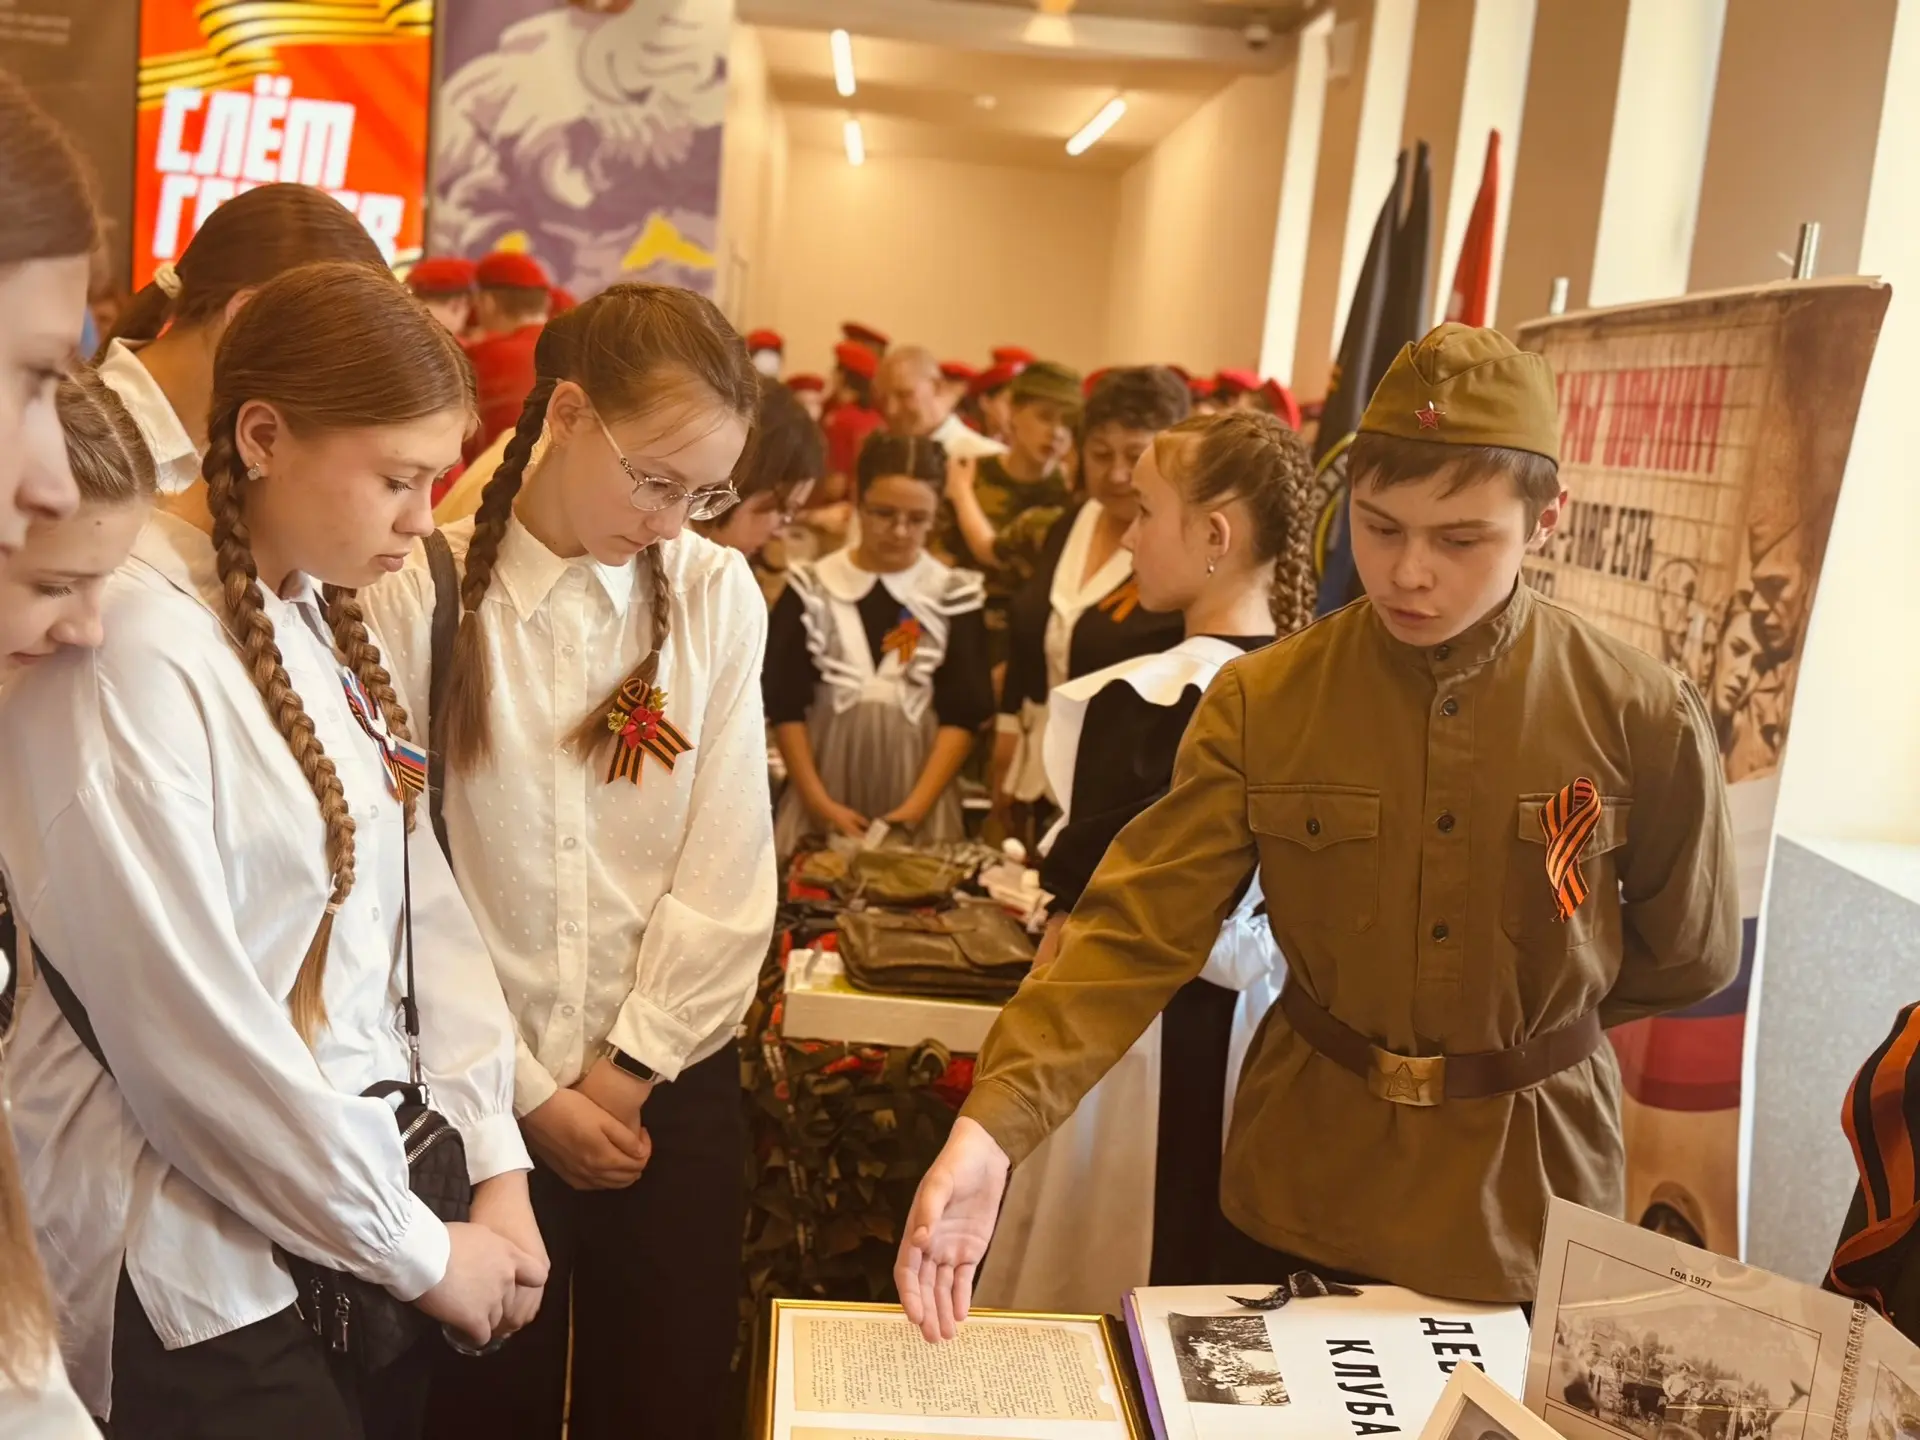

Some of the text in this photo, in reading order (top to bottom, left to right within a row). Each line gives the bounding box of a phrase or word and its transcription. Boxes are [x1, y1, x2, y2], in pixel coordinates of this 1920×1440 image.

[1670, 1267, 1712, 1289] Год 1977
[1325, 1339, 1402, 1436] КЛУБА
